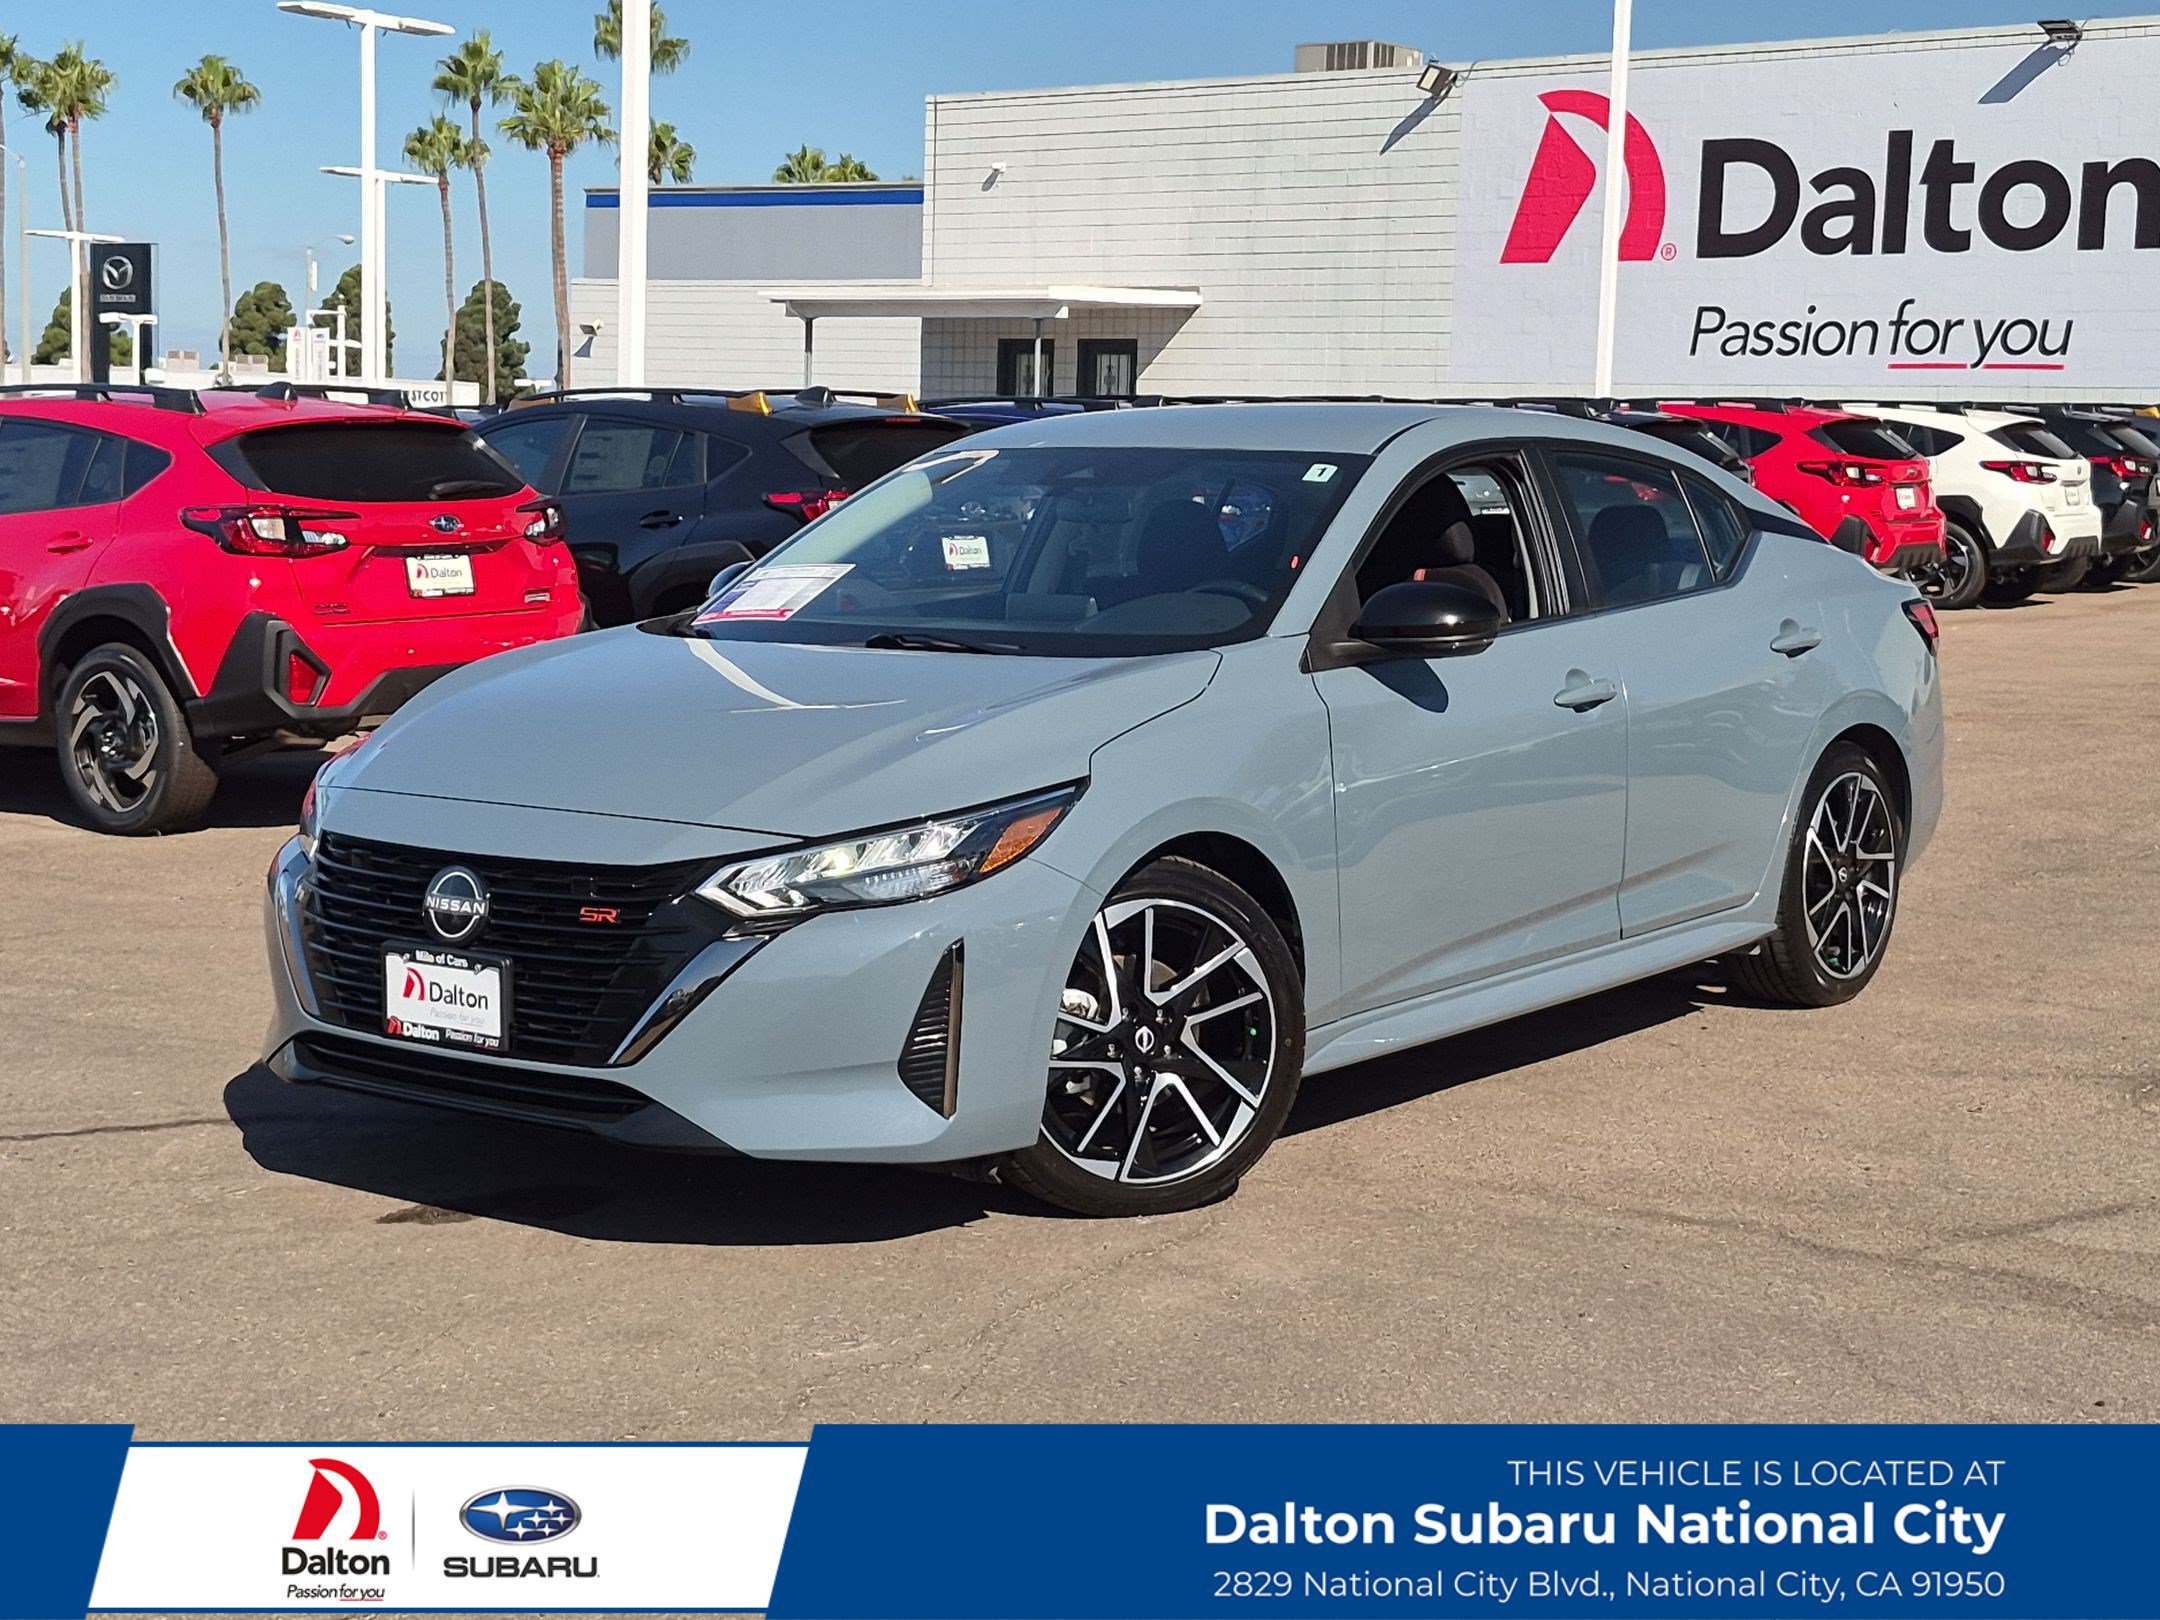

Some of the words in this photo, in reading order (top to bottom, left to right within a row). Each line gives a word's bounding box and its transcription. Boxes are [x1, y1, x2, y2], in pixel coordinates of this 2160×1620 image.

[1696, 129, 2160, 259] Dalton
[1689, 305, 1879, 357] Passion
[1888, 298, 1965, 356] for
[1969, 318, 2074, 370] you
[1316, 467, 1328, 477] 1
[430, 567, 463, 578] Dalton
[425, 895, 486, 915] NISSAN
[579, 907, 620, 923] SR
[436, 953, 446, 964] of
[446, 954, 468, 968] Cars
[429, 980, 488, 1011] Dalton
[430, 1006, 457, 1020] Passion
[459, 1010, 470, 1022] for
[470, 1015, 486, 1025] you
[403, 1021, 440, 1041] Dalton
[445, 1028, 473, 1042] Passion
[474, 1032, 484, 1044] for
[484, 1038, 500, 1048] you
